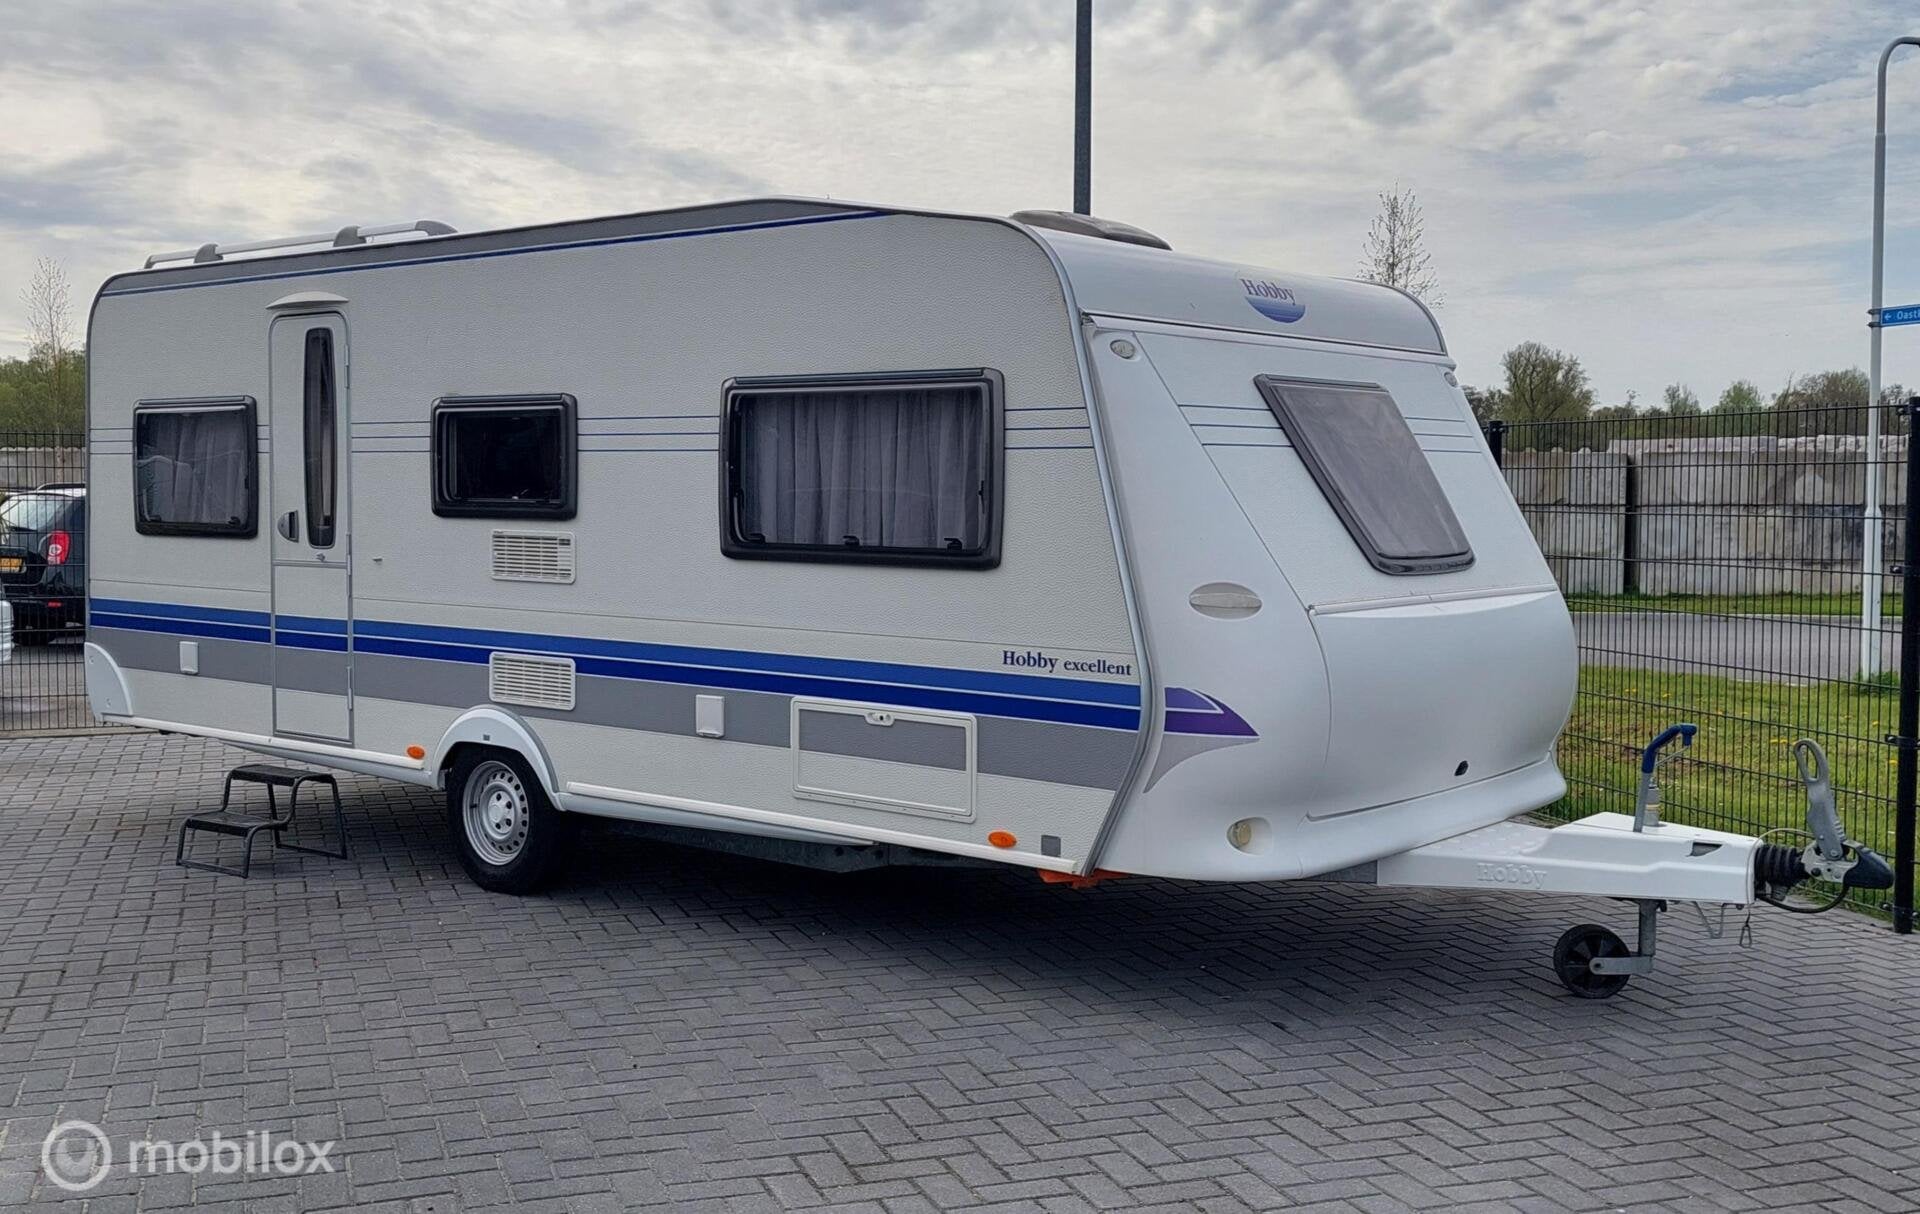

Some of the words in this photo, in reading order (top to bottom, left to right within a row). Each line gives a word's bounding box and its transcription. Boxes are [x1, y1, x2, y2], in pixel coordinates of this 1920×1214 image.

[1240, 278, 1296, 306] Hobby
[1002, 650, 1058, 673] Hobby
[1063, 659, 1132, 676] excellent
[1477, 862, 1547, 890] Hobby
